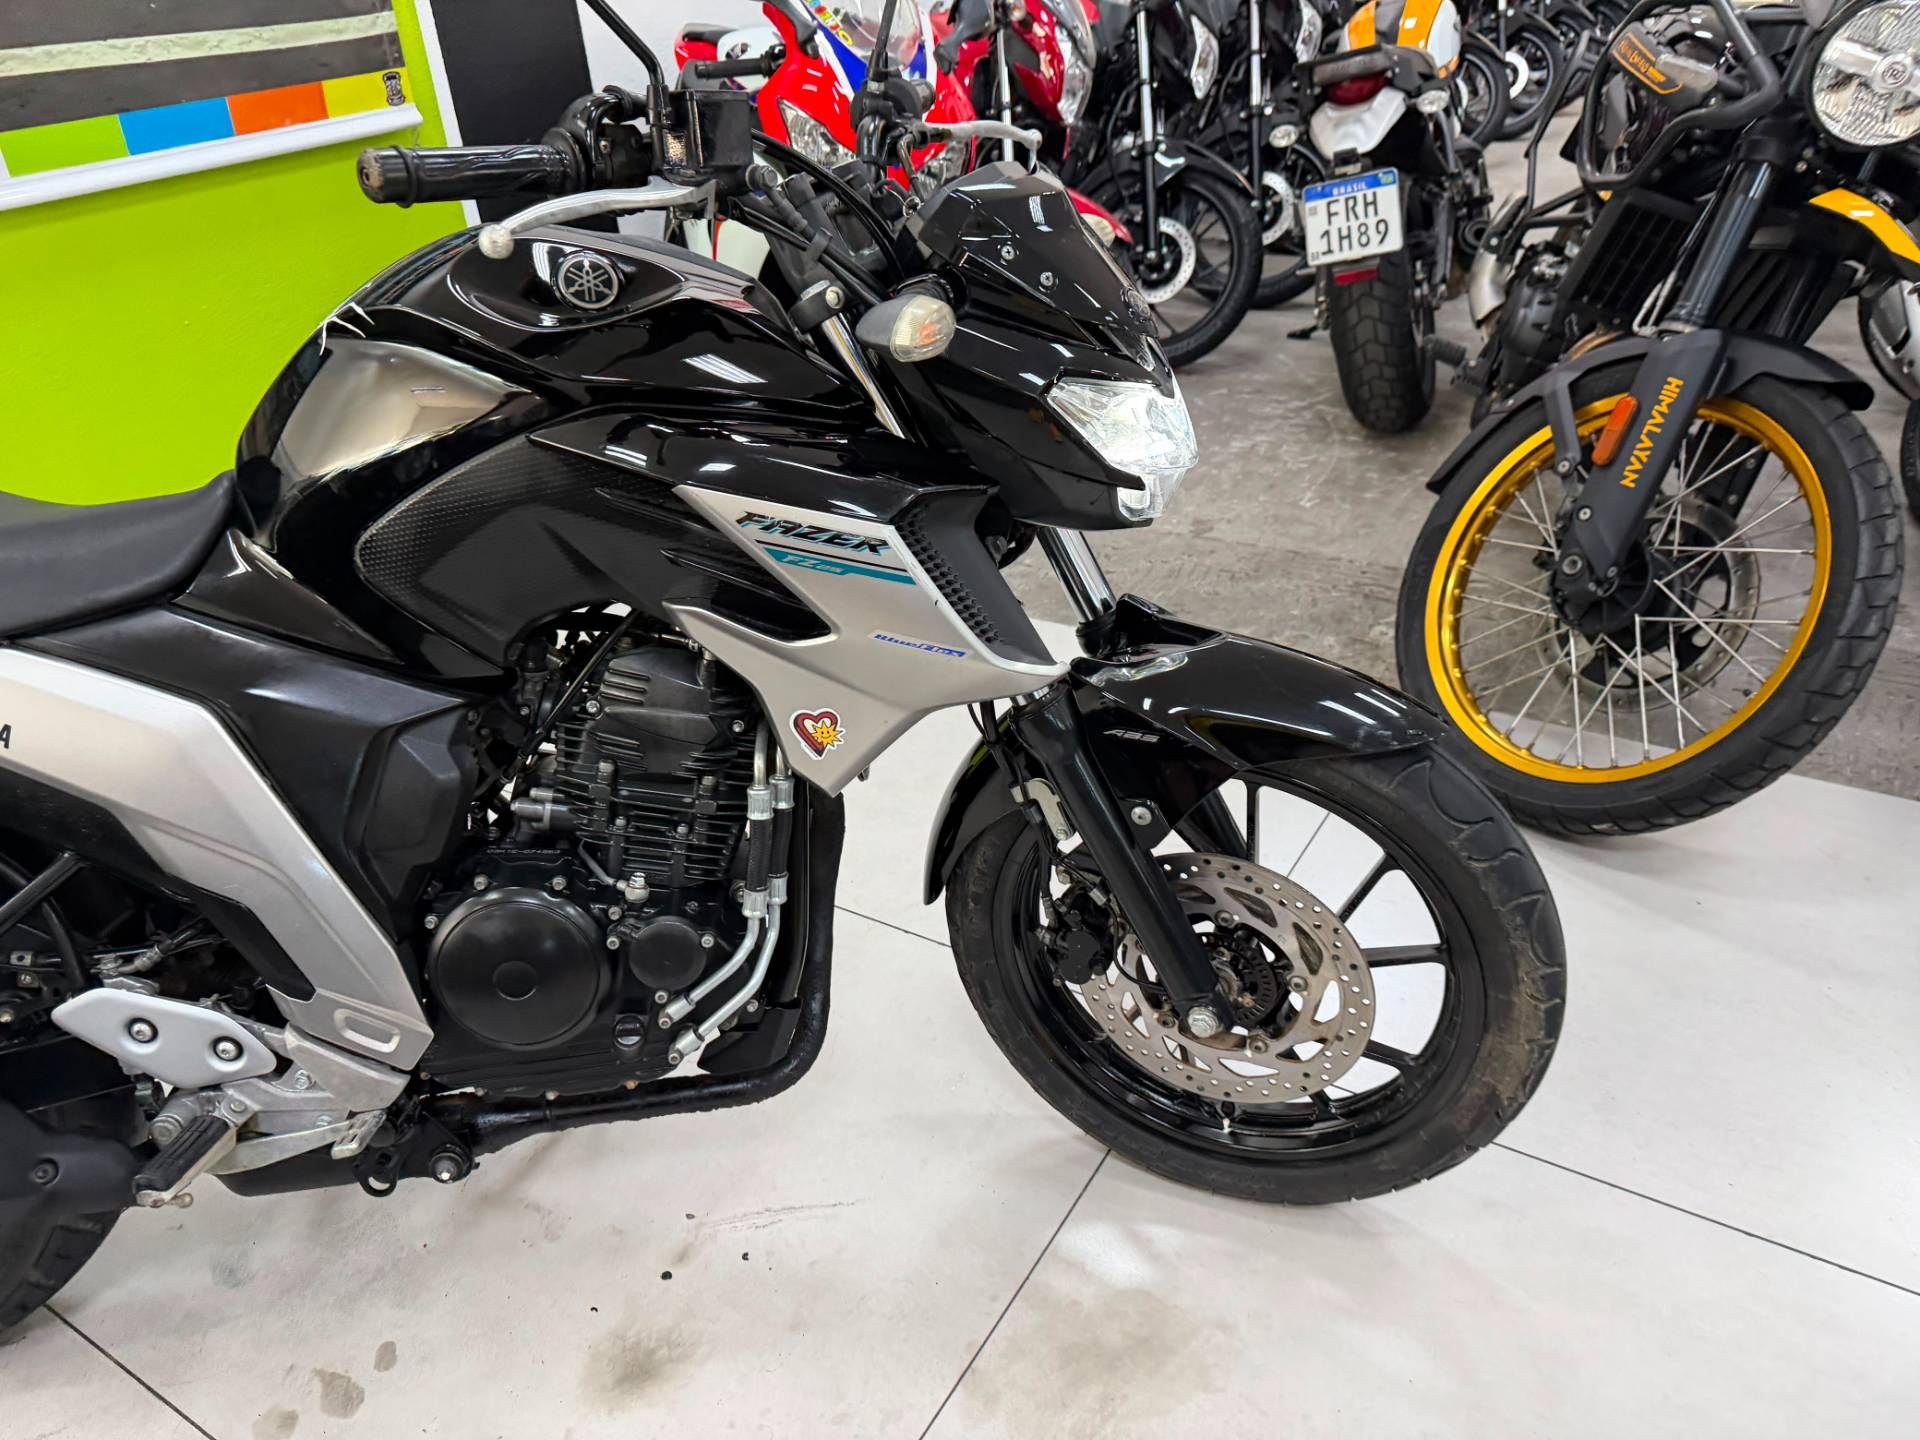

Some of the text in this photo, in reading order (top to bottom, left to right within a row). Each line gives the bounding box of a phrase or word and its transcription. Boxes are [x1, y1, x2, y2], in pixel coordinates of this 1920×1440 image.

[1332, 182, 1367, 196] BRASIL
[1326, 191, 1379, 226] FRH
[1320, 219, 1389, 256] 1H89
[1620, 376, 1685, 488] HIMALAYAN
[736, 511, 892, 556] FAZER
[1103, 729, 1161, 743] ABS
